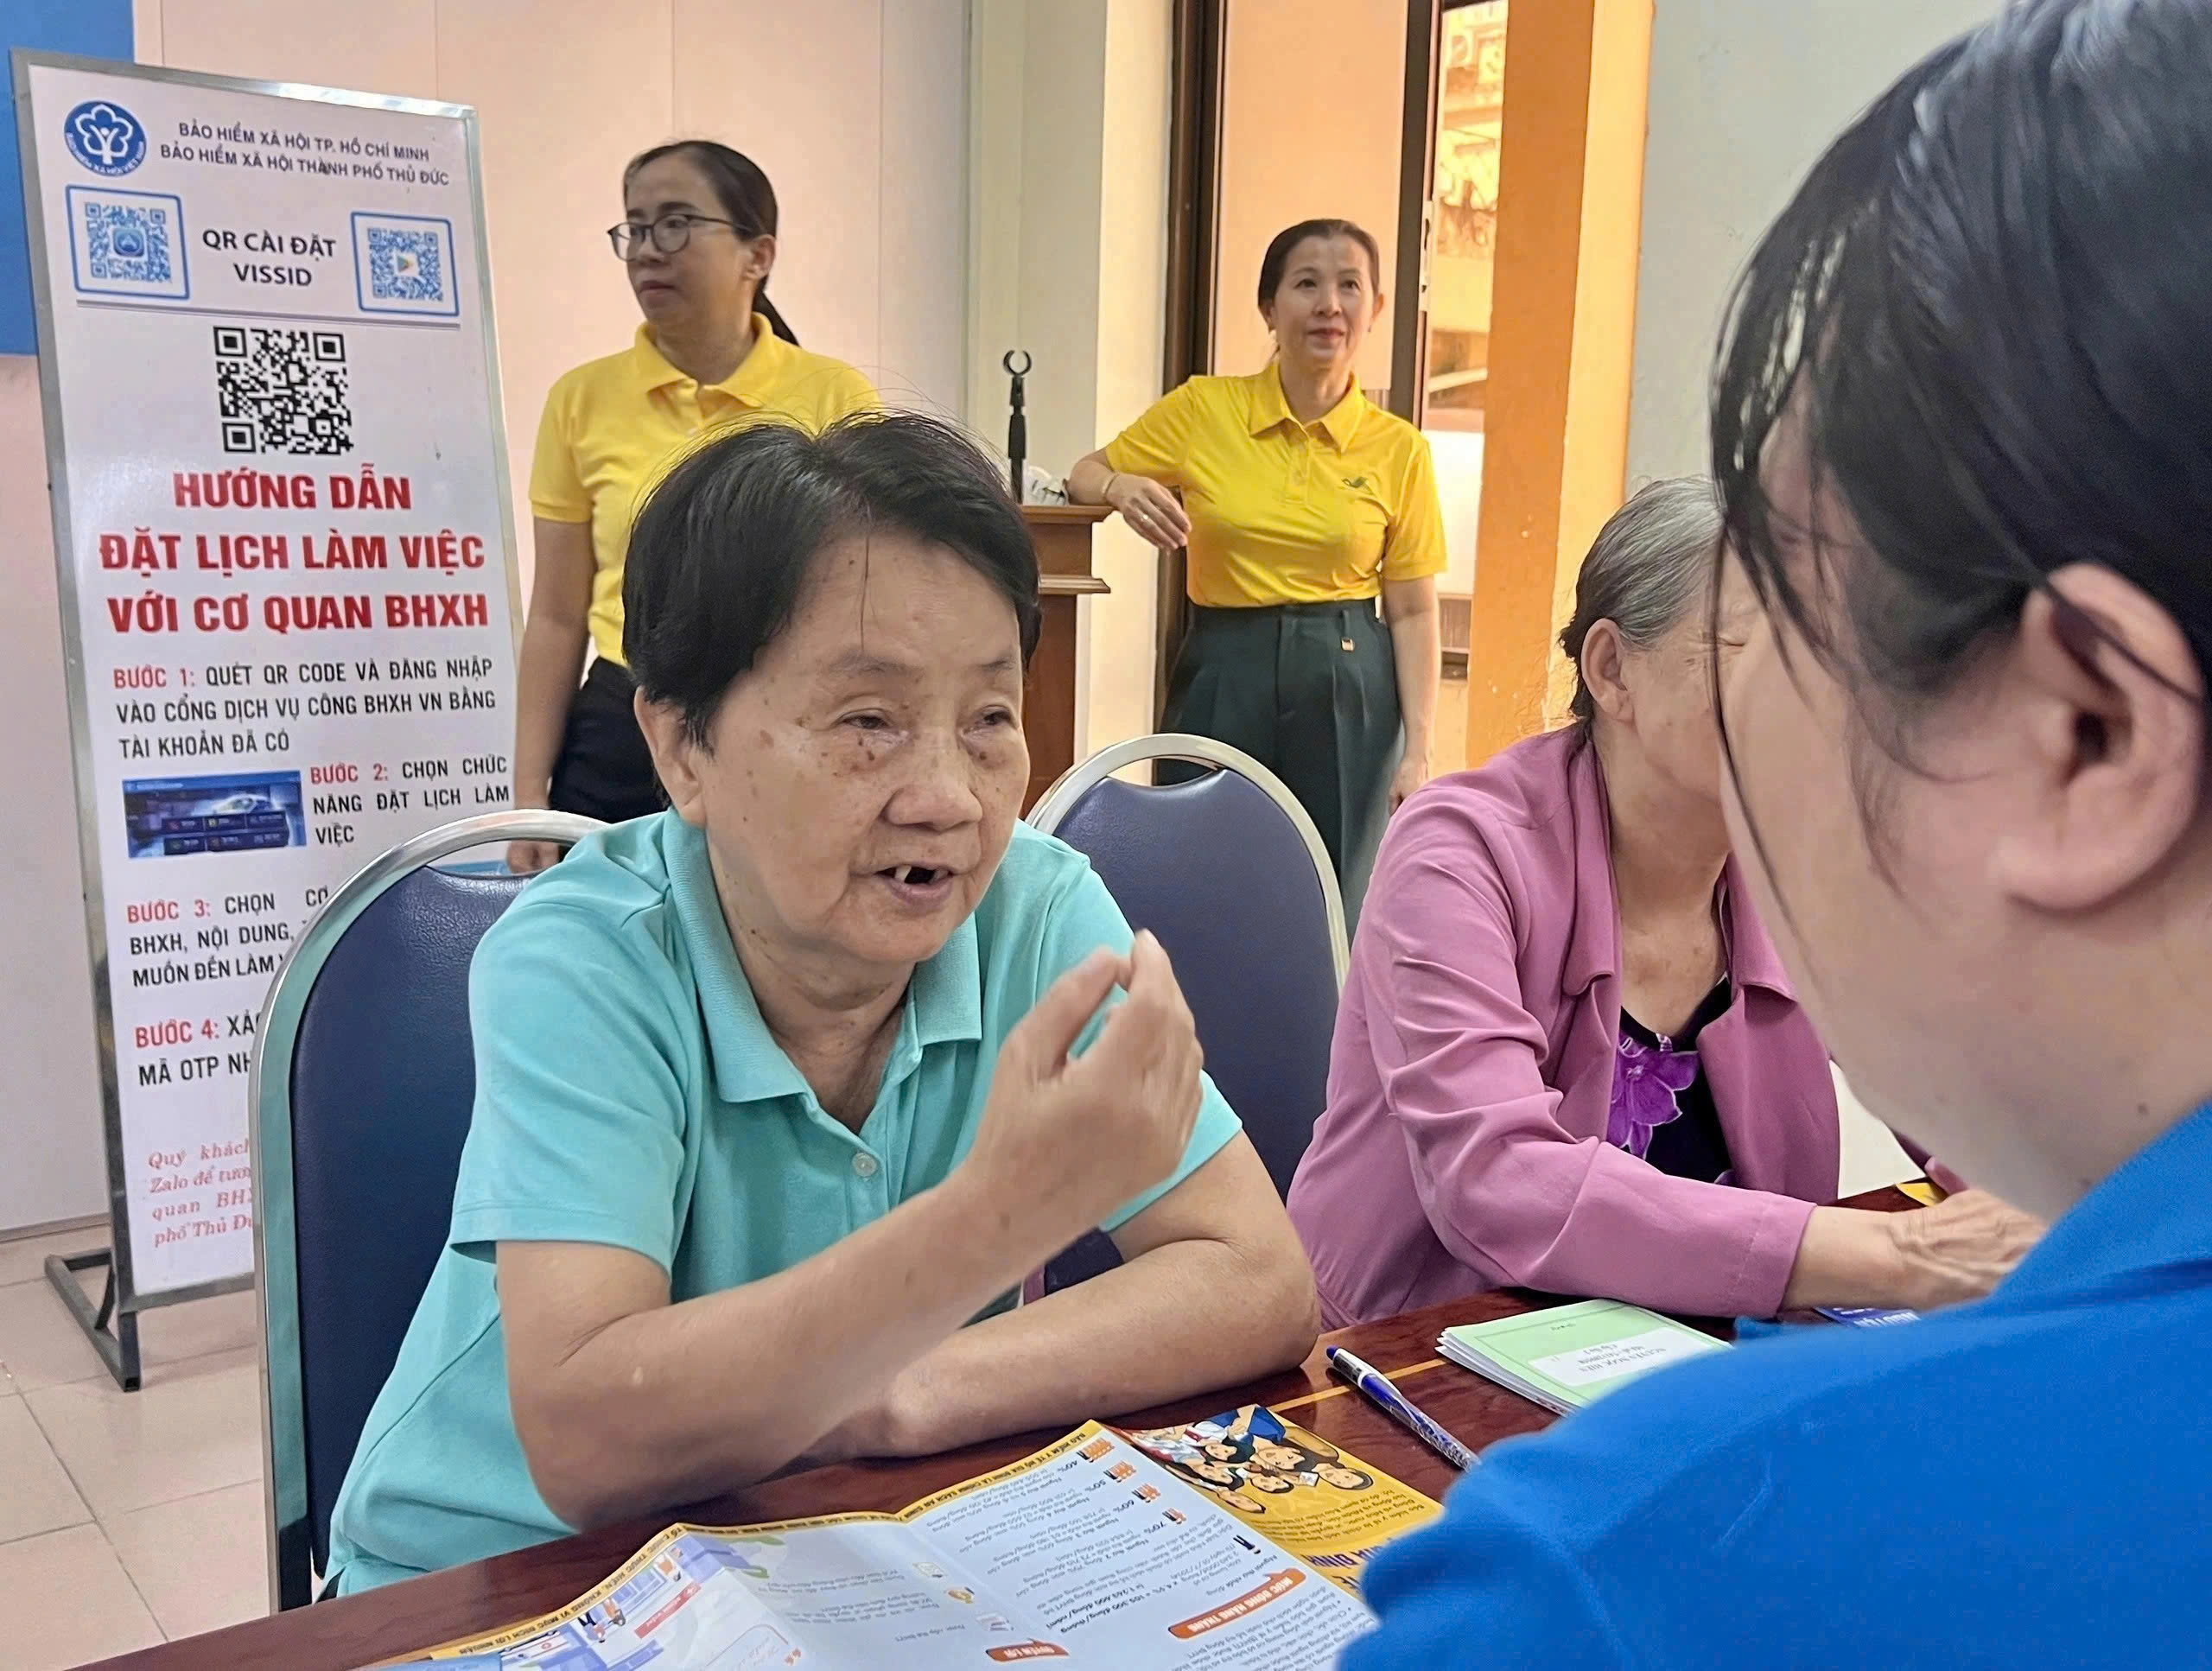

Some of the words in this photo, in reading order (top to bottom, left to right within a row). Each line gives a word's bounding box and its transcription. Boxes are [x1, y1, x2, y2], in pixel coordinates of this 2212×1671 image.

[179, 119, 212, 139] BẢO
[217, 121, 254, 143] HIỂM
[261, 129, 281, 145] XÃ
[285, 133, 310, 151] HỘI
[315, 137, 336, 152] TP.
[340, 137, 360, 155] HỒ
[365, 141, 390, 156] CHÍ
[393, 145, 429, 161] MINH
[161, 142, 194, 162] BẢO
[199, 143, 236, 165] HIỂM
[243, 150, 263, 168] XÃ
[268, 156, 293, 173] HỘI
[299, 156, 347, 176] THÀNH
[353, 160, 383, 180] PHỐ
[387, 162, 416, 183] THỦ
[421, 166, 449, 185] ĐỨC
[203, 229, 237, 251] QR
[244, 229, 283, 254] CÀI
[290, 232, 336, 261] ĐẶT
[234, 263, 311, 286] VISSID
[174, 467, 316, 510] HƯỚNG
[330, 462, 411, 510] DẪN
[99, 526, 181, 577] ĐẶT
[196, 534, 289, 577] LỊCH
[302, 529, 387, 569] LÀM
[400, 529, 485, 576] VIỆC
[107, 589, 178, 632] VỚI
[193, 594, 249, 632] CƠ
[264, 594, 372, 633] QUAN
[385, 594, 488, 628] BHXH
[113, 665, 167, 689] BƯỚC
[180, 667, 195, 688] 1:
[207, 659, 252, 687] QUÉT
[264, 664, 289, 685] QR
[299, 662, 346, 683] CODE
[356, 658, 379, 682] VÀ
[390, 658, 436, 681] ĐĂNG
[447, 654, 492, 682] NHẬP
[117, 700, 156, 724] VÀO
[164, 693, 216, 721] CỔNG
[225, 698, 268, 724] DỊCH
[276, 697, 300, 721] VỤ
[308, 693, 356, 716] CÔNG
[365, 693, 411, 714] BHXH
[418, 693, 442, 712] VN
[449, 686, 495, 710] BẰNG
[119, 733, 149, 759] TÀI
[159, 730, 224, 757] KHOẢN
[232, 728, 257, 754] ĐÃ
[265, 727, 289, 752] CÓ
[311, 762, 359, 785] BƯỚC
[373, 762, 388, 781] 2:
[402, 760, 448, 784] CHỌN
[463, 754, 507, 776] CHỨC
[313, 792, 362, 815] NĂNG
[377, 790, 409, 813] ĐẶT
[424, 788, 461, 811] LỊCH
[475, 783, 509, 804] LÀM
[316, 824, 354, 847] VIỆC
[127, 899, 179, 924] BƯỚC
[194, 899, 211, 918] 3:
[224, 893, 276, 917] CHỌN
[130, 933, 188, 955] BHXH,
[198, 926, 228, 950] NỘI
[239, 923, 295, 944] DUNG,
[133, 958, 189, 988] MUỐN
[195, 955, 231, 981] ĐẾN
[237, 953, 274, 976] LÀM
[135, 1020, 193, 1049] BƯỚC
[201, 1019, 219, 1039] 4:
[138, 1058, 172, 1086] MÃ
[181, 1056, 218, 1081] OTP
[149, 1174, 188, 1193] Zalo
[152, 1201, 200, 1221] quan
